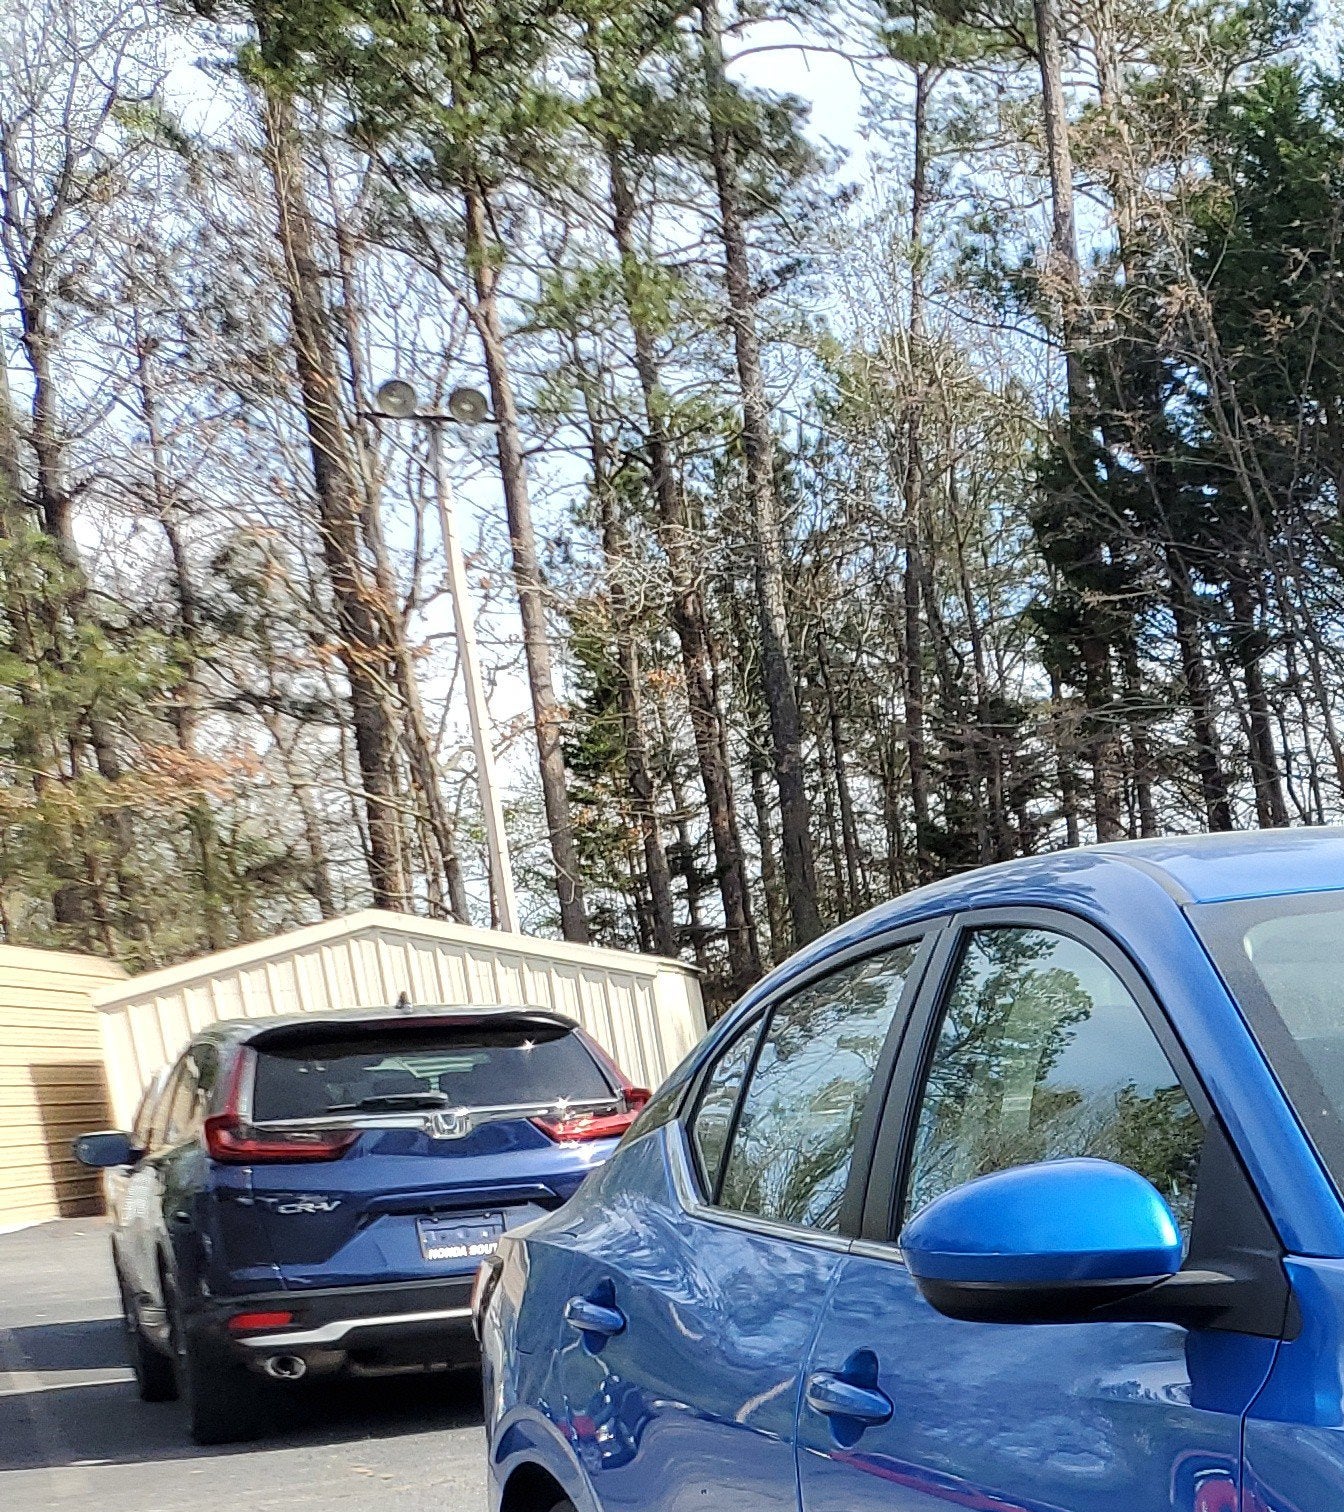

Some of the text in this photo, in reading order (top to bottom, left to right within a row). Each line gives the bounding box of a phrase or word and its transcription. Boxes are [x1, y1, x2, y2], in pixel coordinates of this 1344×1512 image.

[278, 1200, 341, 1214] CR-V
[428, 1242, 499, 1260] HONDA SOUT
